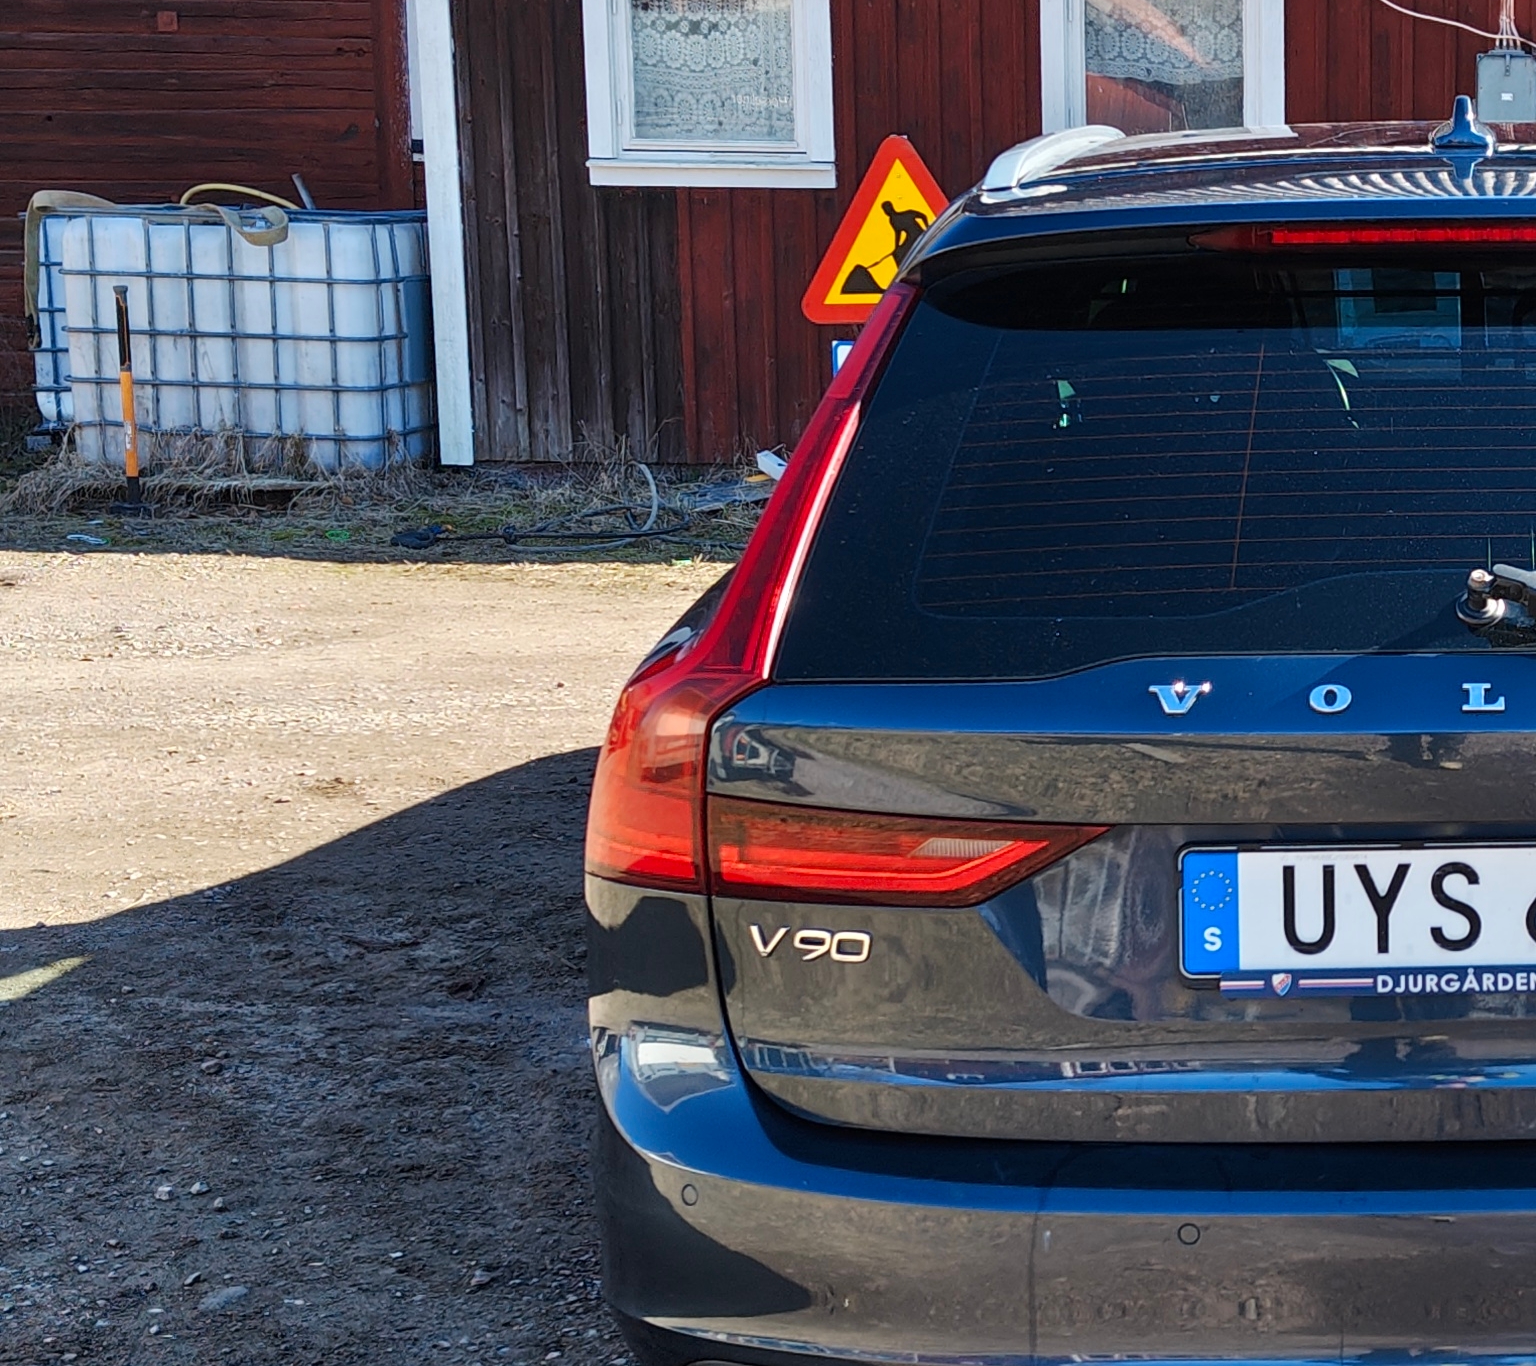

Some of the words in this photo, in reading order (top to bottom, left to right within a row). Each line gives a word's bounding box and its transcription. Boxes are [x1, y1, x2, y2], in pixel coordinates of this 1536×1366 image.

[1282, 862, 1482, 955] UYS
[750, 924, 871, 963] V90
[1203, 926, 1222, 952] S
